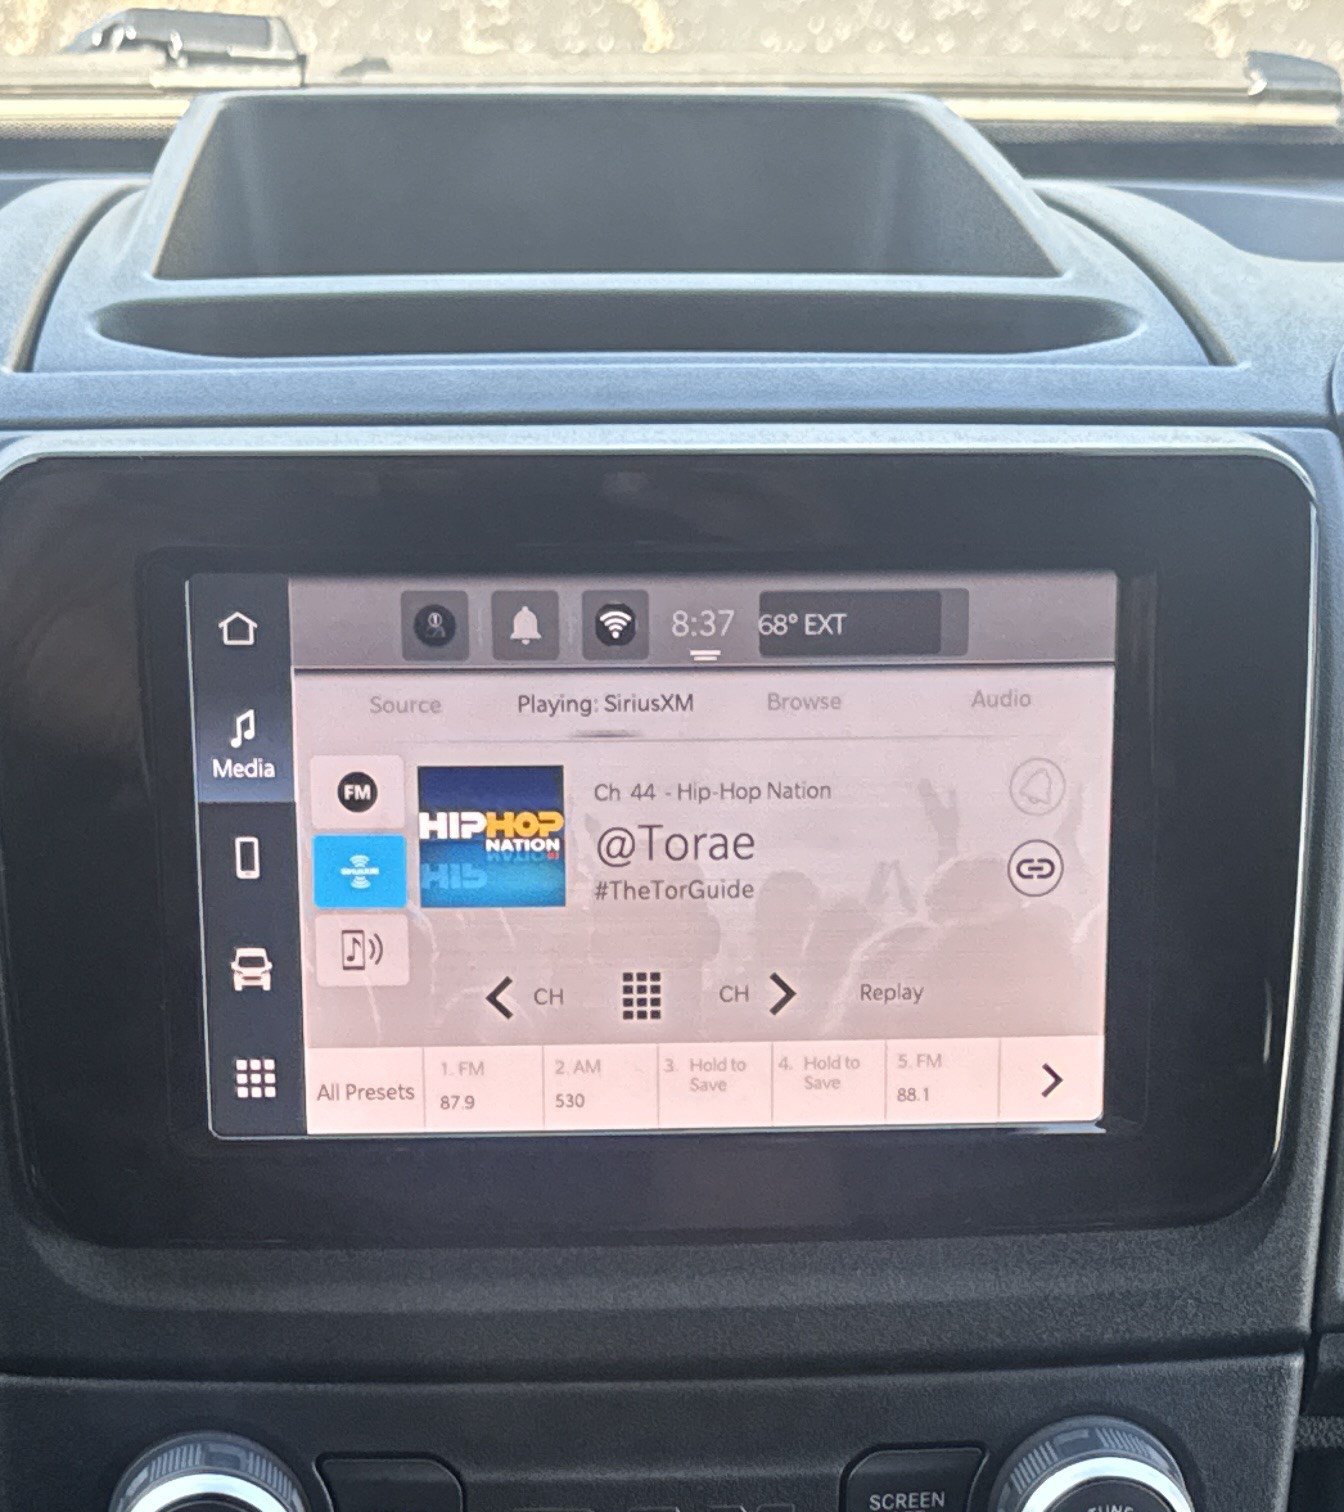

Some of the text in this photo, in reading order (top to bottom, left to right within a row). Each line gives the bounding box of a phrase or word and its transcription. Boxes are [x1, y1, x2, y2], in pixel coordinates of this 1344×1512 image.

[671, 610, 735, 637] 8:37
[758, 613, 847, 635] 68° EXT
[370, 697, 442, 714] Source
[518, 694, 694, 717] Playing: SiriusXM
[767, 693, 842, 711] Browse
[971, 689, 1031, 708] Audio
[212, 759, 275, 778] Media
[343, 785, 371, 801] FM
[594, 784, 621, 801] Ch
[630, 784, 655, 800] 44
[677, 783, 761, 803] Hip-Hop
[767, 782, 831, 799] Nation
[485, 838, 561, 852] NATION
[597, 824, 755, 867] @Torae
[594, 880, 755, 900] #TheTorGuide
[534, 988, 564, 1006] CH
[719, 986, 749, 1002] CH
[860, 984, 924, 1004] Replay
[459, 1062, 484, 1076] FM
[574, 1059, 601, 1074] AM
[690, 1058, 725, 1072] Hold
[728, 1059, 746, 1072] to
[804, 1056, 839, 1071] Hold
[842, 1057, 860, 1070] to
[917, 1053, 942, 1068] FM
[690, 1077, 727, 1092] Save
[804, 1075, 841, 1090] Save
[317, 1083, 415, 1101] All Presets
[897, 1087, 929, 1102] 88.1
[440, 1095, 475, 1110] 87.9
[555, 1094, 585, 1108] 530
[869, 1492, 945, 1511] SCREEN
